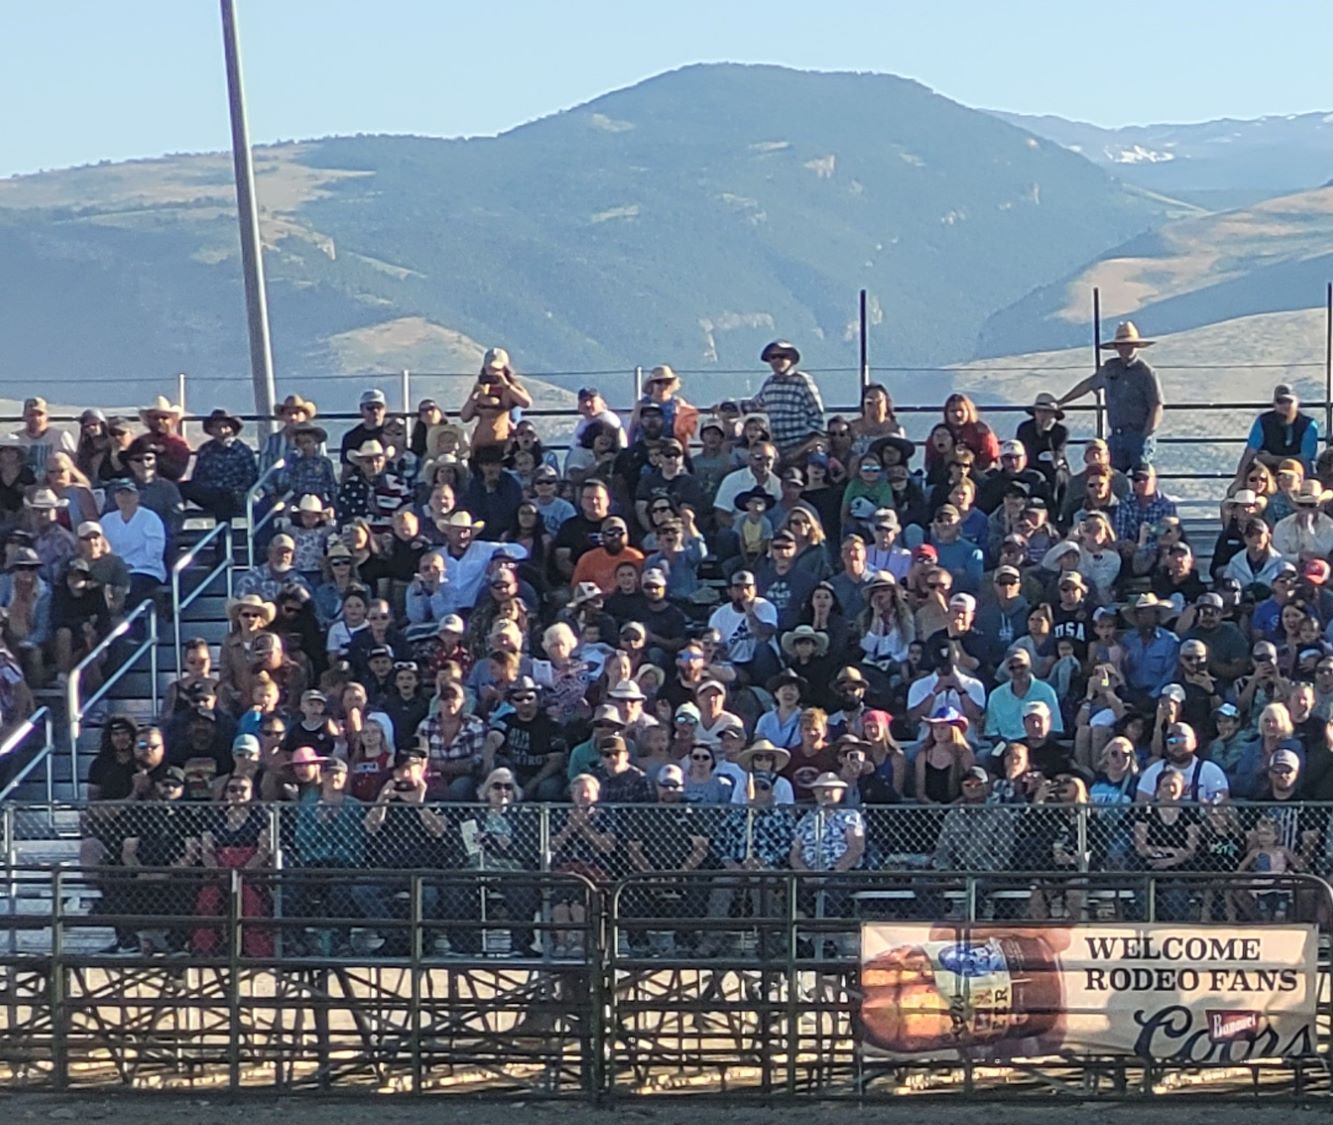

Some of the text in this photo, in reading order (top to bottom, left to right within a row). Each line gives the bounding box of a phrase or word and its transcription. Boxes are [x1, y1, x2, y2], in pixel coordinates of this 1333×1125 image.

[1054, 621, 1086, 642] USA
[1085, 936, 1260, 961] WELCOME
[1084, 967, 1299, 992] RODEO FANS
[1133, 1004, 1313, 1064] Coors
